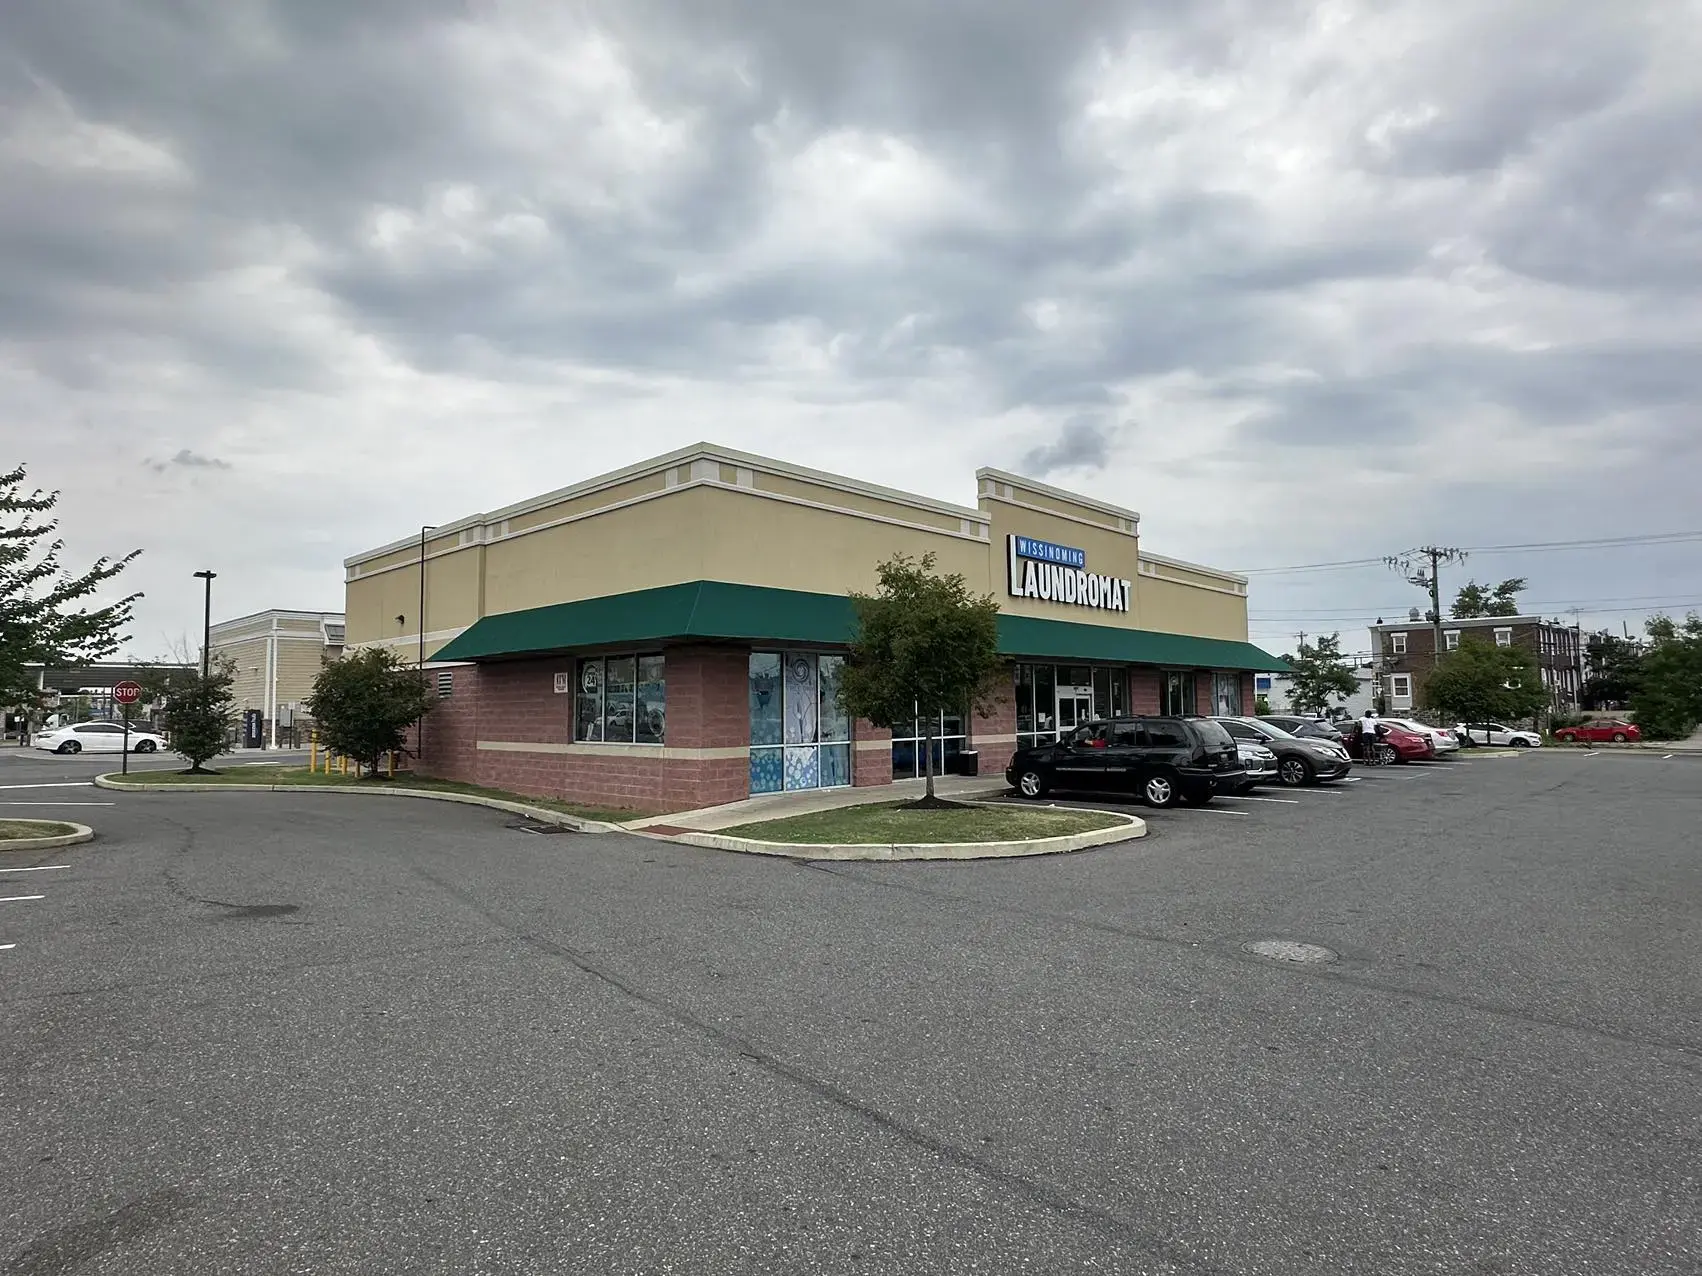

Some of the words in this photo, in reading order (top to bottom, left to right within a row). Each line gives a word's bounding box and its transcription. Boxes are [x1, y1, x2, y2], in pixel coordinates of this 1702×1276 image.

[1019, 539, 1083, 565] WISSINOMING
[1009, 534, 1131, 611] LAUNDROMAT
[116, 687, 140, 696] STOP
